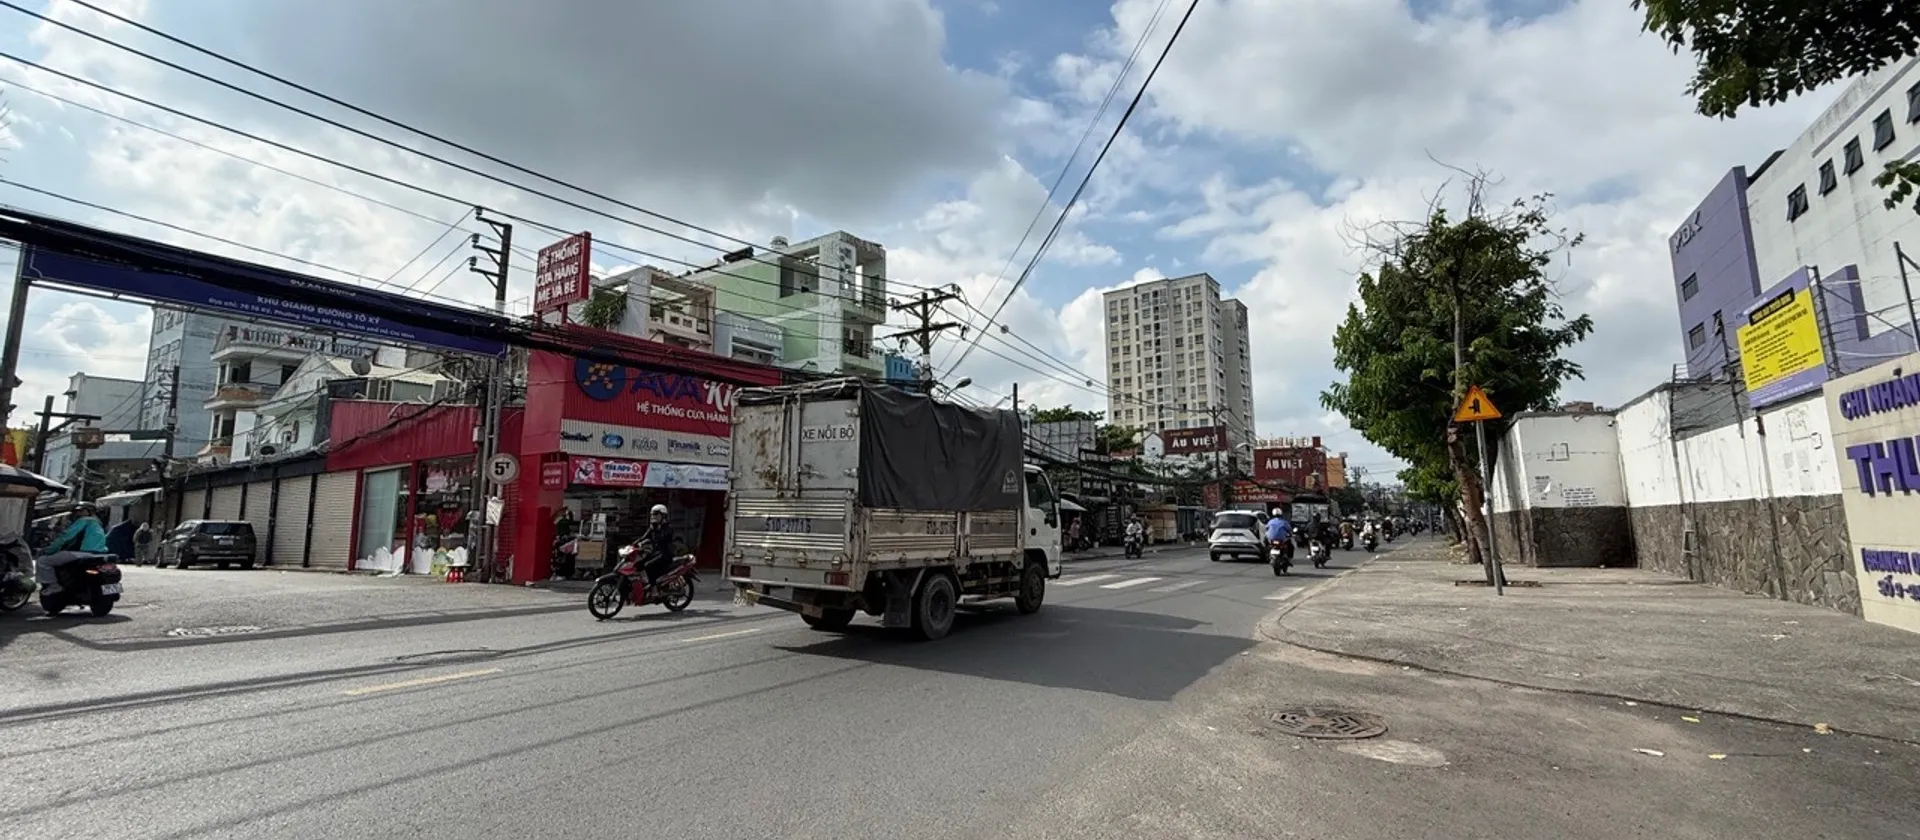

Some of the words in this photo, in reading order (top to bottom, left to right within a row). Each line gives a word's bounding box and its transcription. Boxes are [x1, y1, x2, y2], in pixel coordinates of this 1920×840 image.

[551, 241, 580, 265] THỐNG
[554, 262, 579, 281] HÀNG
[257, 296, 279, 306] KHU
[703, 379, 733, 412] Ki
[1839, 387, 1870, 420] CHI
[1868, 367, 1920, 414] NHÁN
[637, 401, 650, 415] HỆ
[651, 402, 685, 418] THỐNG
[686, 407, 705, 420] CỬA
[706, 411, 728, 423] HÀN
[802, 429, 816, 440] XE
